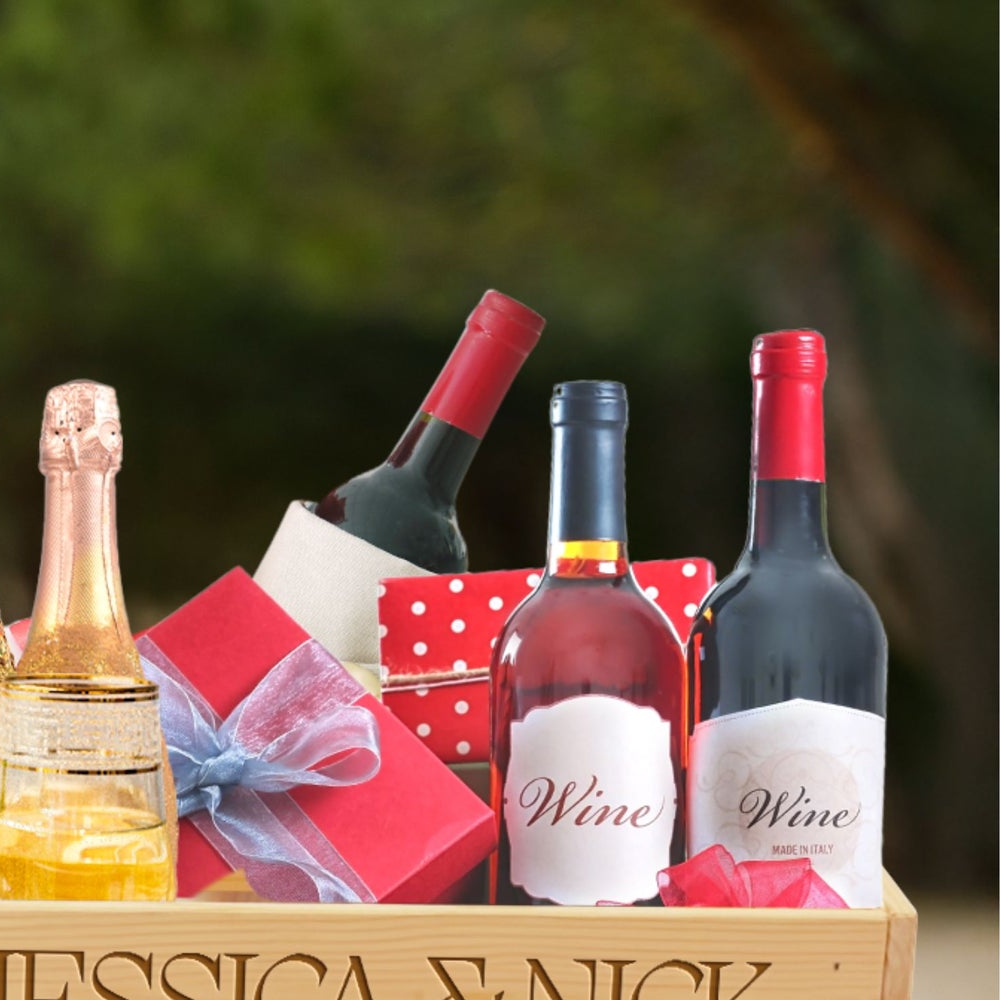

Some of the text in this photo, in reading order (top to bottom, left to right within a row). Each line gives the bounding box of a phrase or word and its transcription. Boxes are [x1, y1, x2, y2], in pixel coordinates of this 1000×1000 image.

[519, 775, 665, 829] Wine
[739, 785, 862, 829] Wine
[771, 844, 834, 856] MADE IN ITALY
